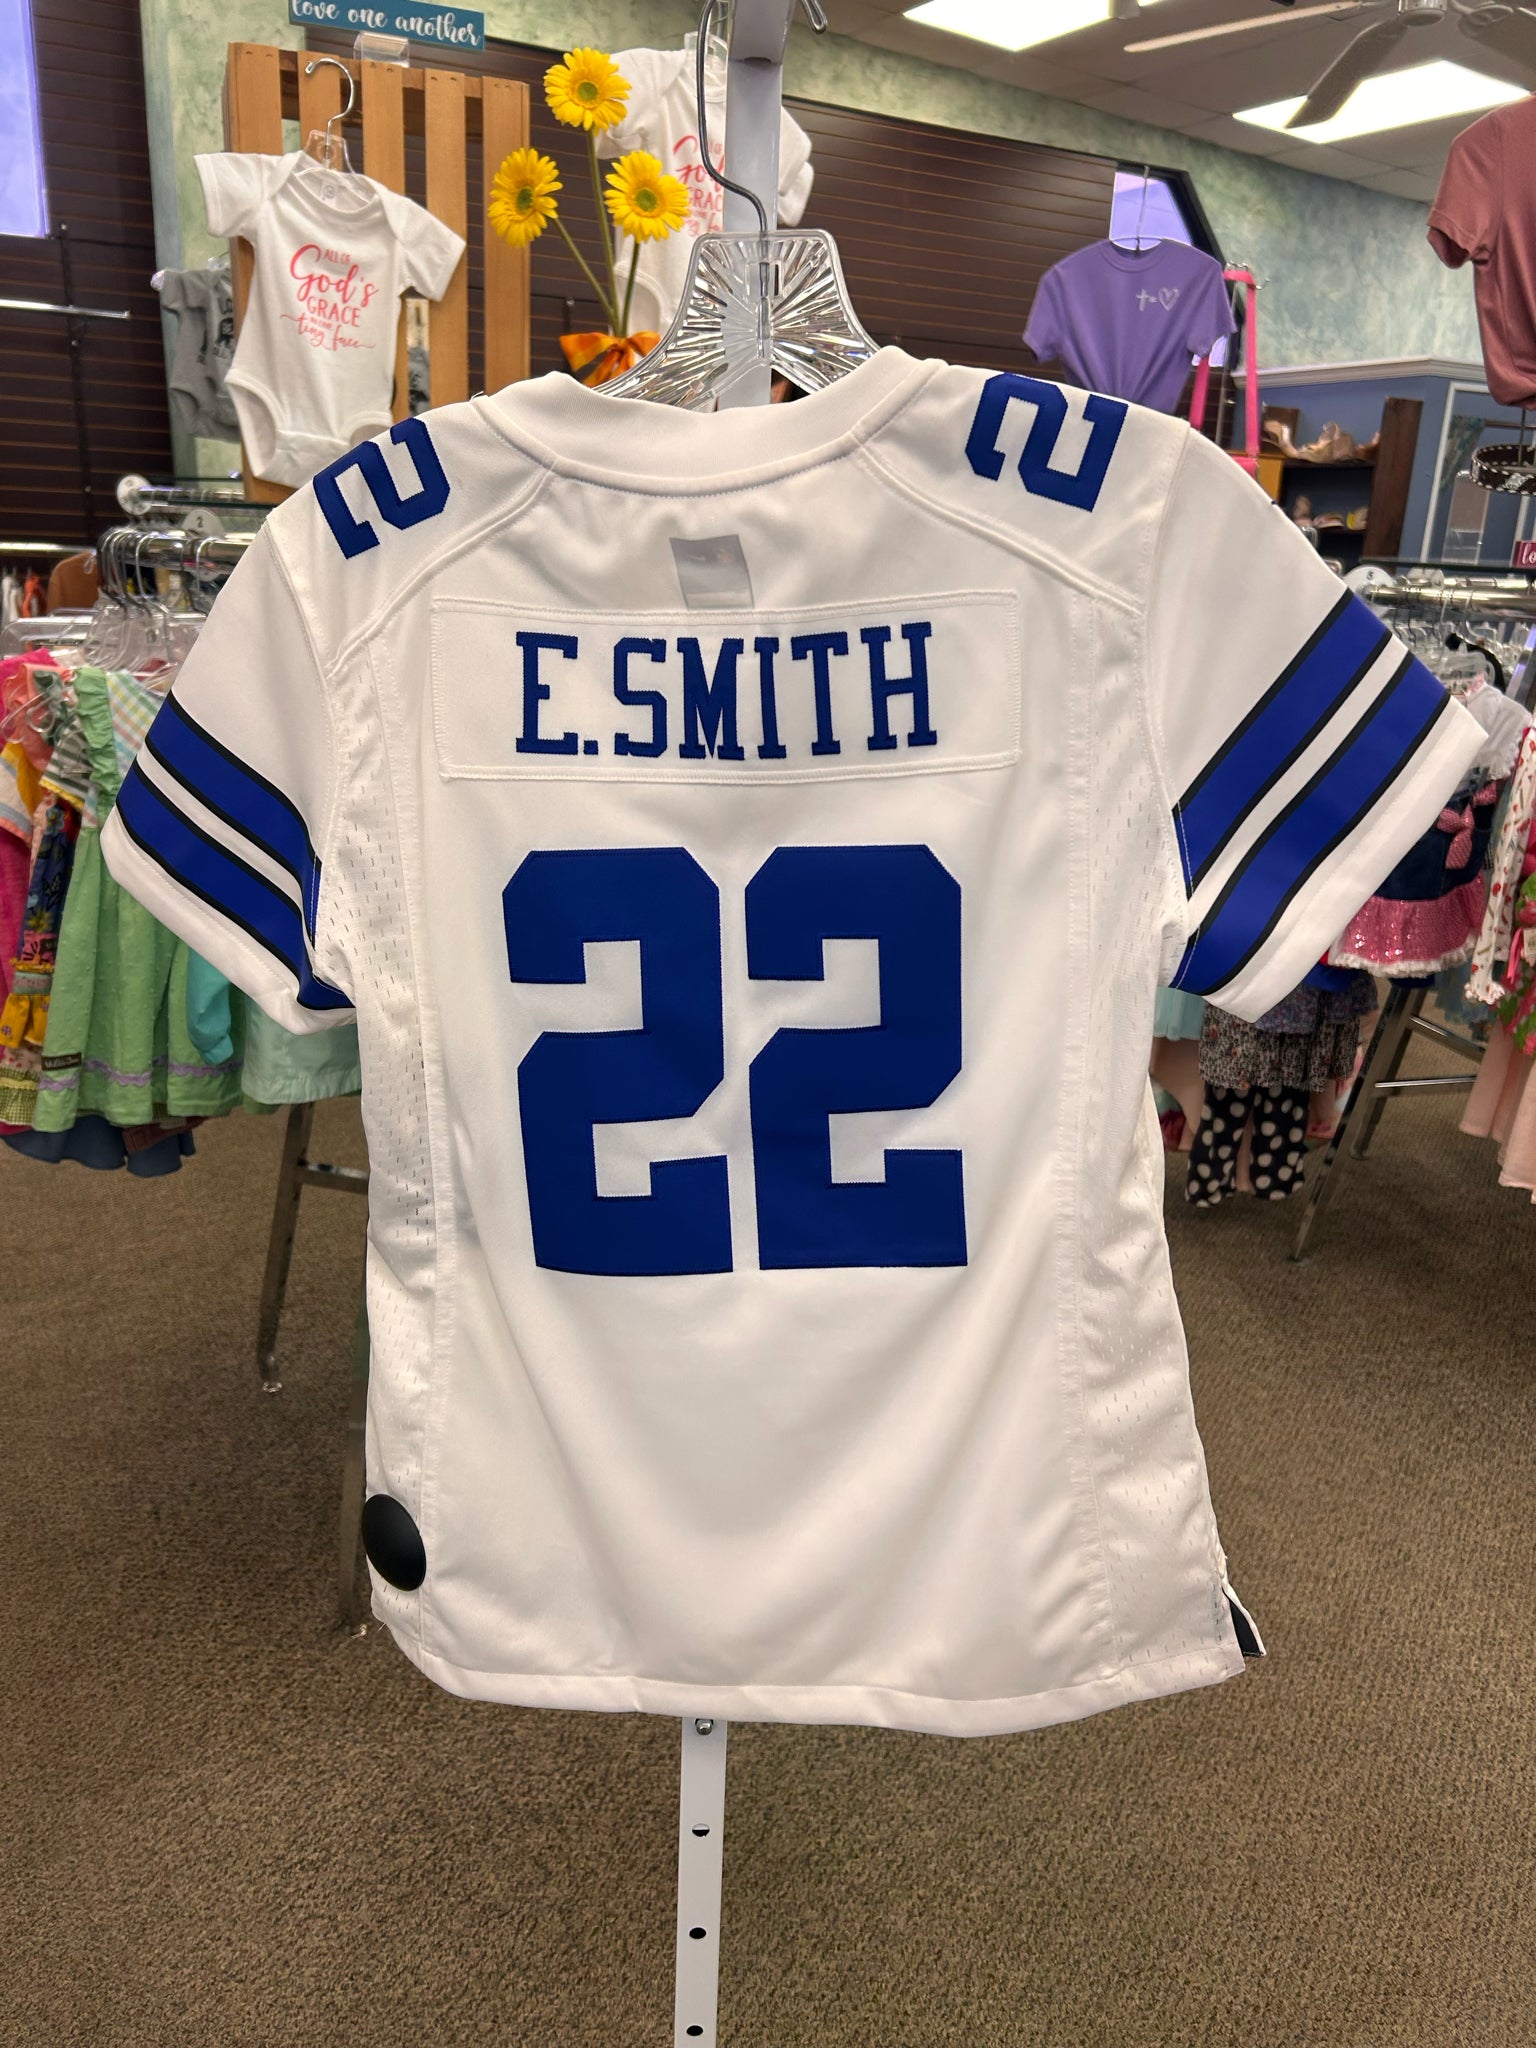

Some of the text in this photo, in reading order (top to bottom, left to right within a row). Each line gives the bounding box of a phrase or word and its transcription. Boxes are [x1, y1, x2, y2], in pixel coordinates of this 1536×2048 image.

[292, 0, 482, 47] love one another
[290, 244, 379, 308] God's
[307, 296, 361, 328] GRACE
[313, 417, 451, 560] 2
[965, 372, 1129, 513] 2
[196, 516, 204, 528] 2
[516, 621, 938, 761] E.SMITH
[502, 844, 968, 1277] 22
